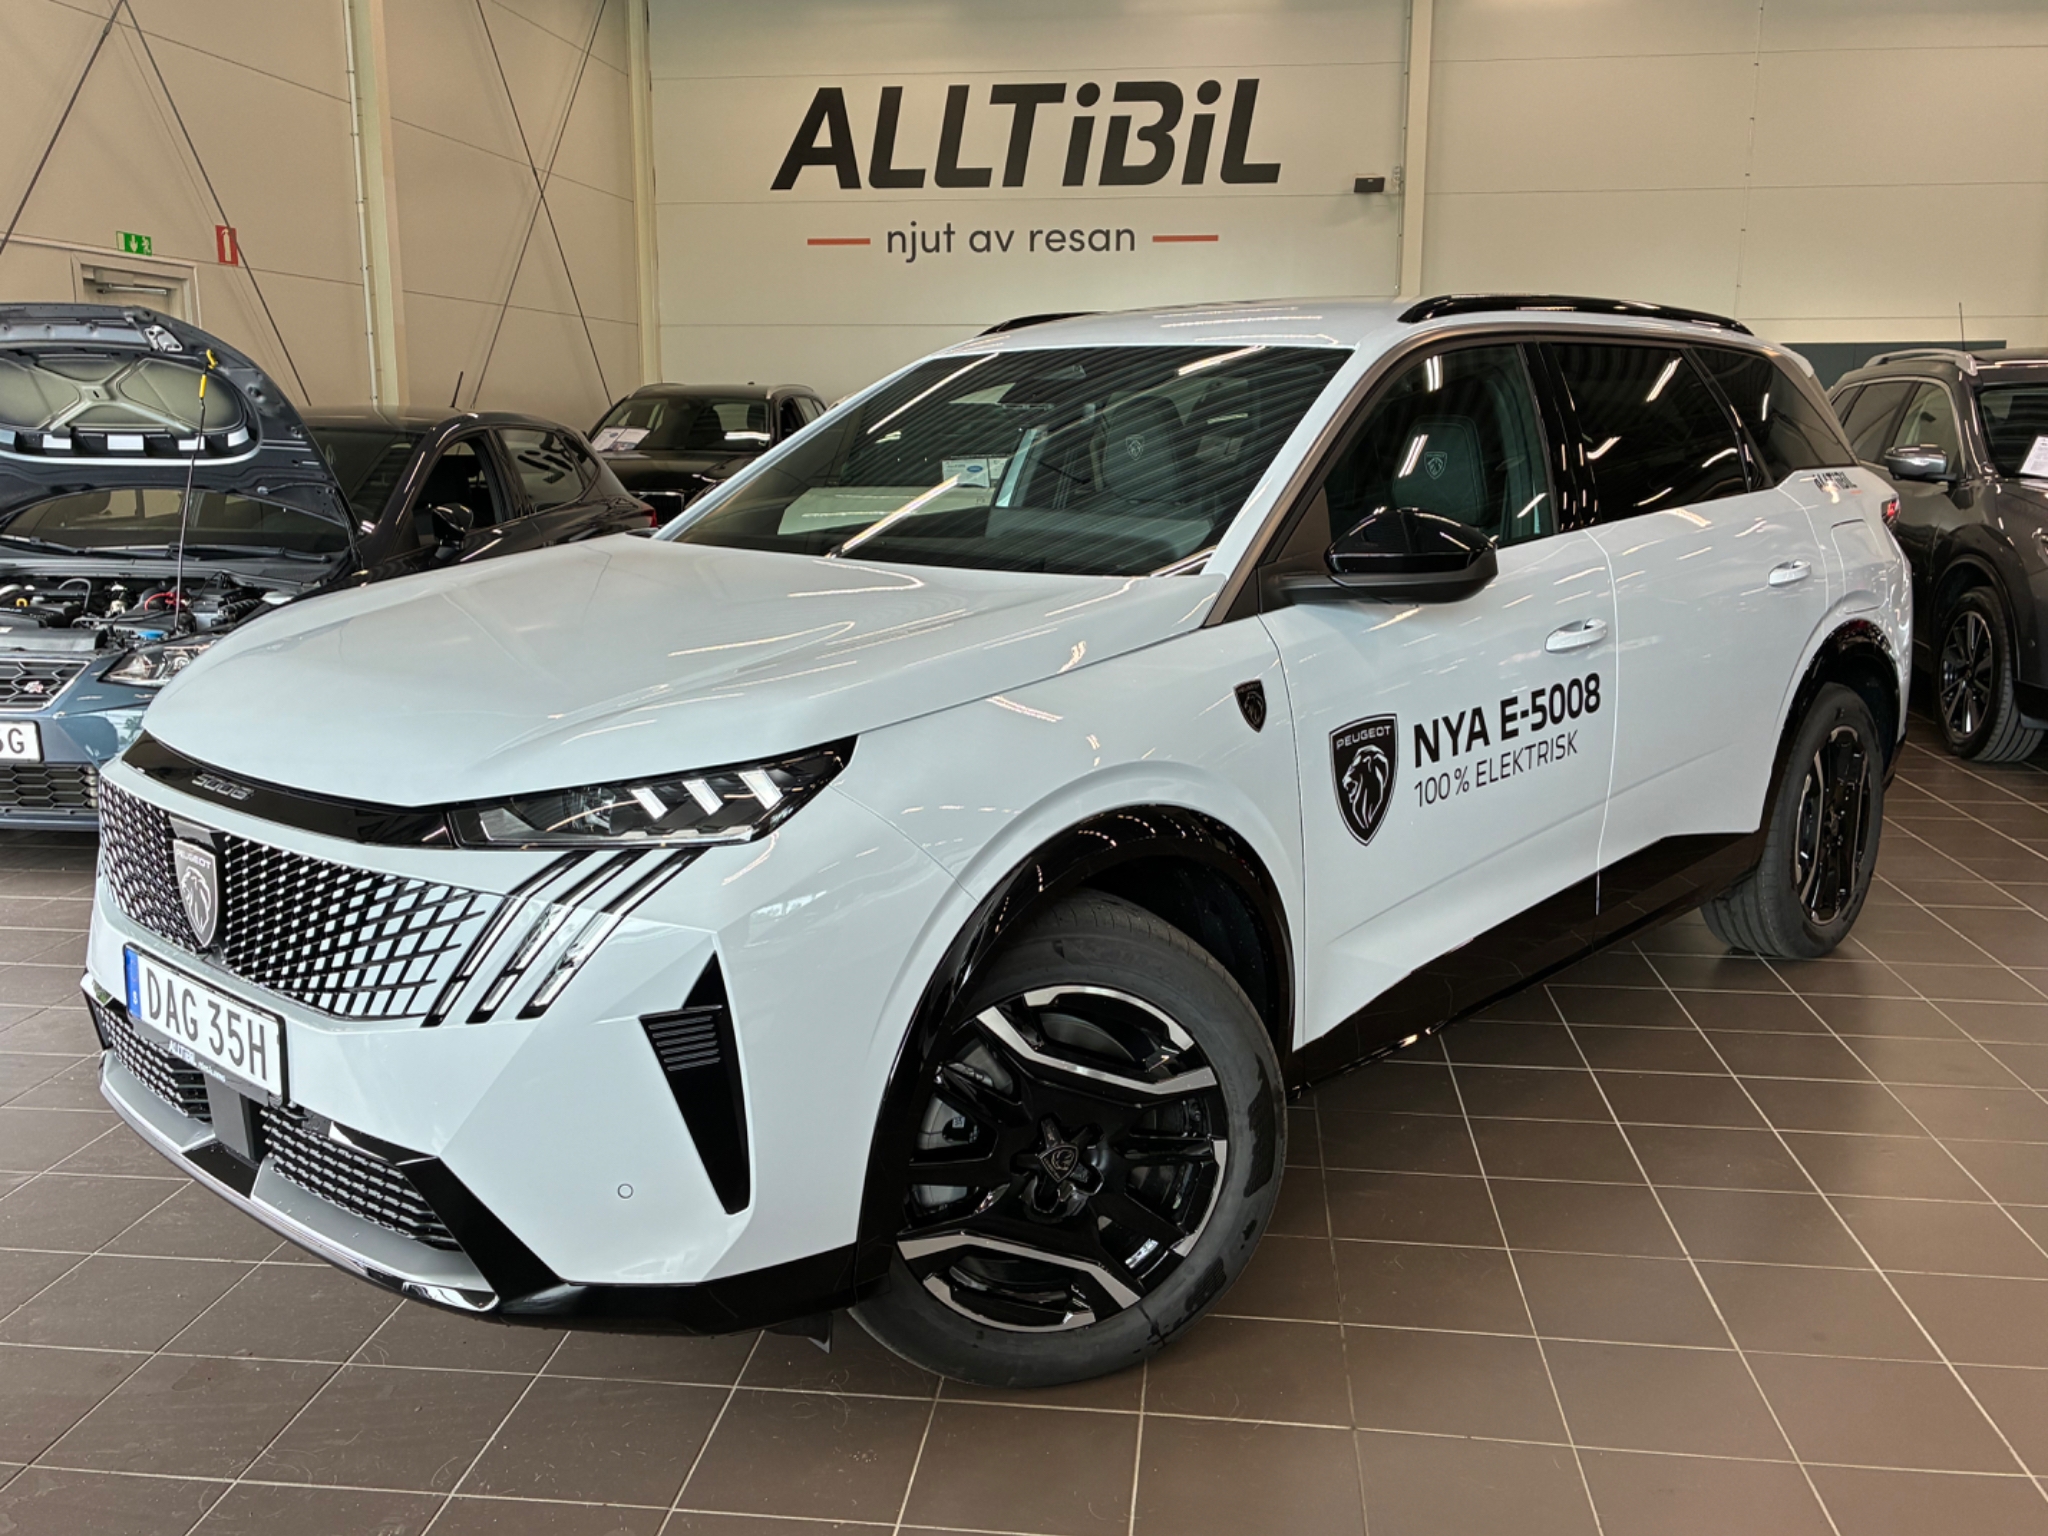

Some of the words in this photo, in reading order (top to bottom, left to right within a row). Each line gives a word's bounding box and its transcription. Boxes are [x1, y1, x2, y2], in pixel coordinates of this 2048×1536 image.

[887, 221, 956, 264] njut
[969, 230, 1015, 253] av
[1029, 228, 1136, 253] resan
[0, 727, 26, 755] G
[1335, 724, 1392, 751] PEUGEOT
[1413, 706, 1491, 769] NYA
[1499, 672, 1602, 742] E-5008
[1476, 731, 1579, 789] ELEKTRISK
[146, 967, 199, 1043] DAG
[207, 999, 268, 1082] 35H
